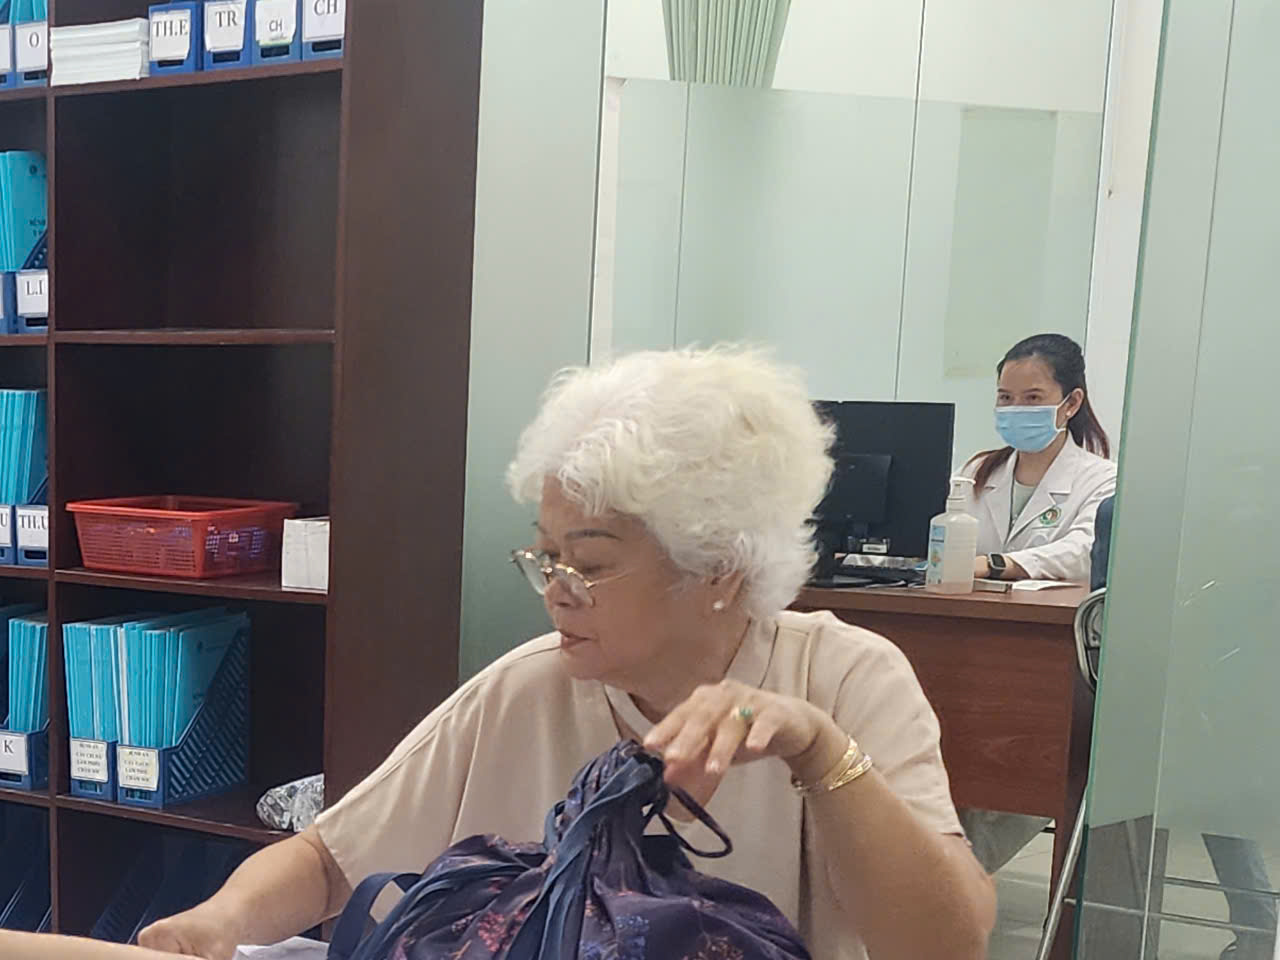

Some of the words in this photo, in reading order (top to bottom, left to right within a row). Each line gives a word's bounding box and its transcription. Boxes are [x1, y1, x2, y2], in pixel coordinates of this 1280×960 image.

[313, 0, 338, 16] CH
[214, 10, 239, 28] TR
[268, 19, 283, 33] CH
[3, 740, 13, 754] K
